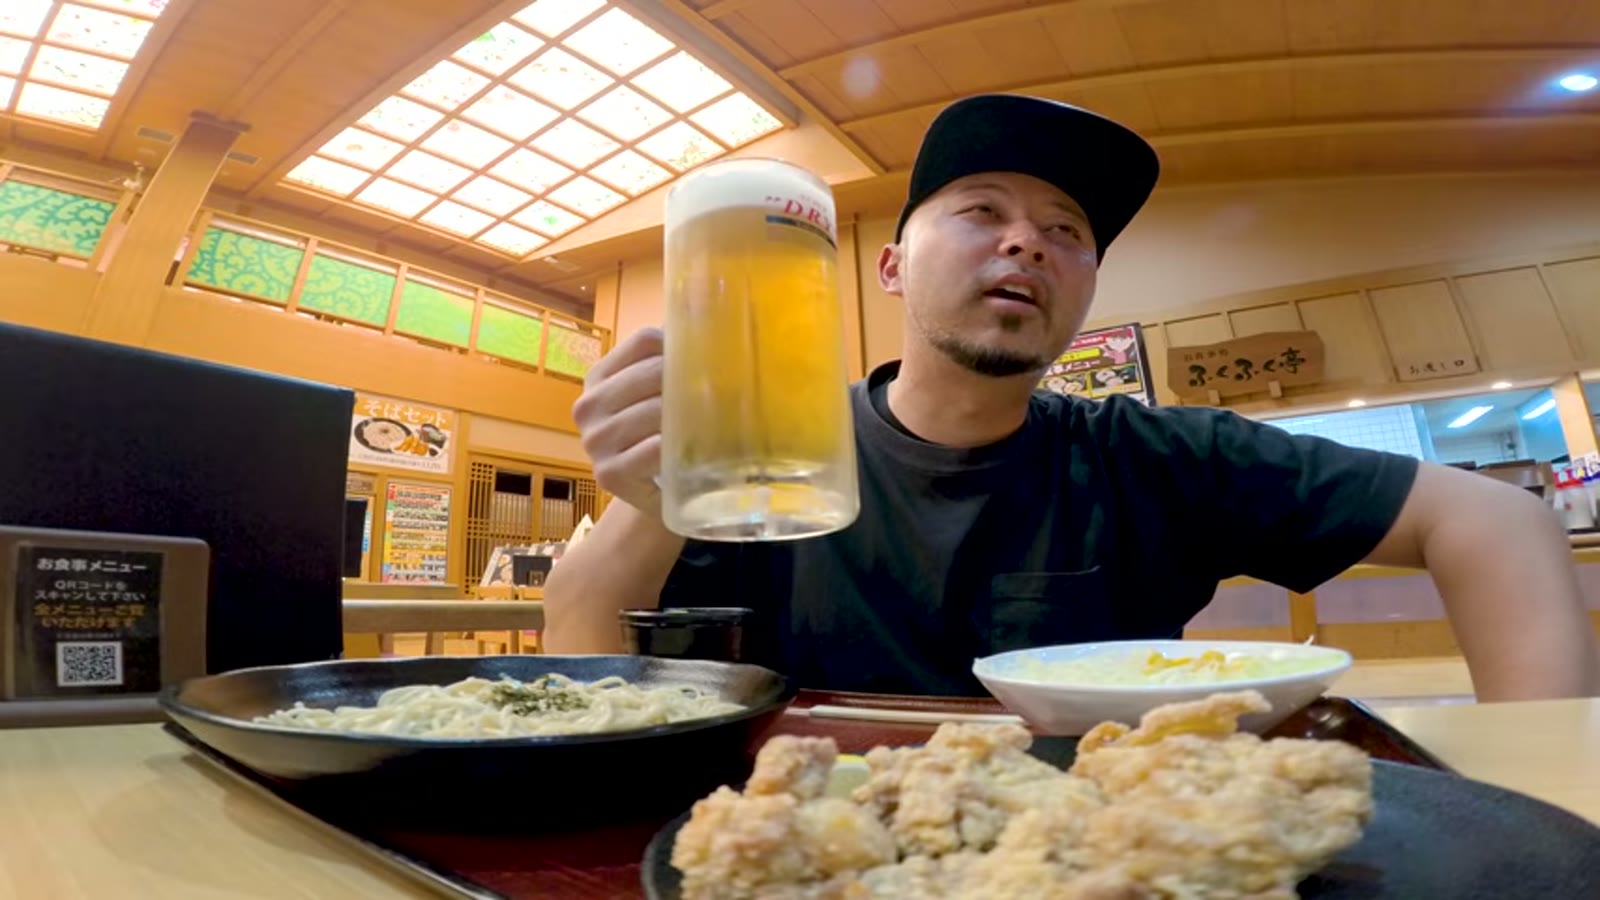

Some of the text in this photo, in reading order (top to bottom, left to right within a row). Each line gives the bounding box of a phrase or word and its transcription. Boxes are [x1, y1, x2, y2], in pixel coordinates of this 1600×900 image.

[364, 400, 447, 427] そばセット
[37, 558, 147, 572] お食事メニュー
